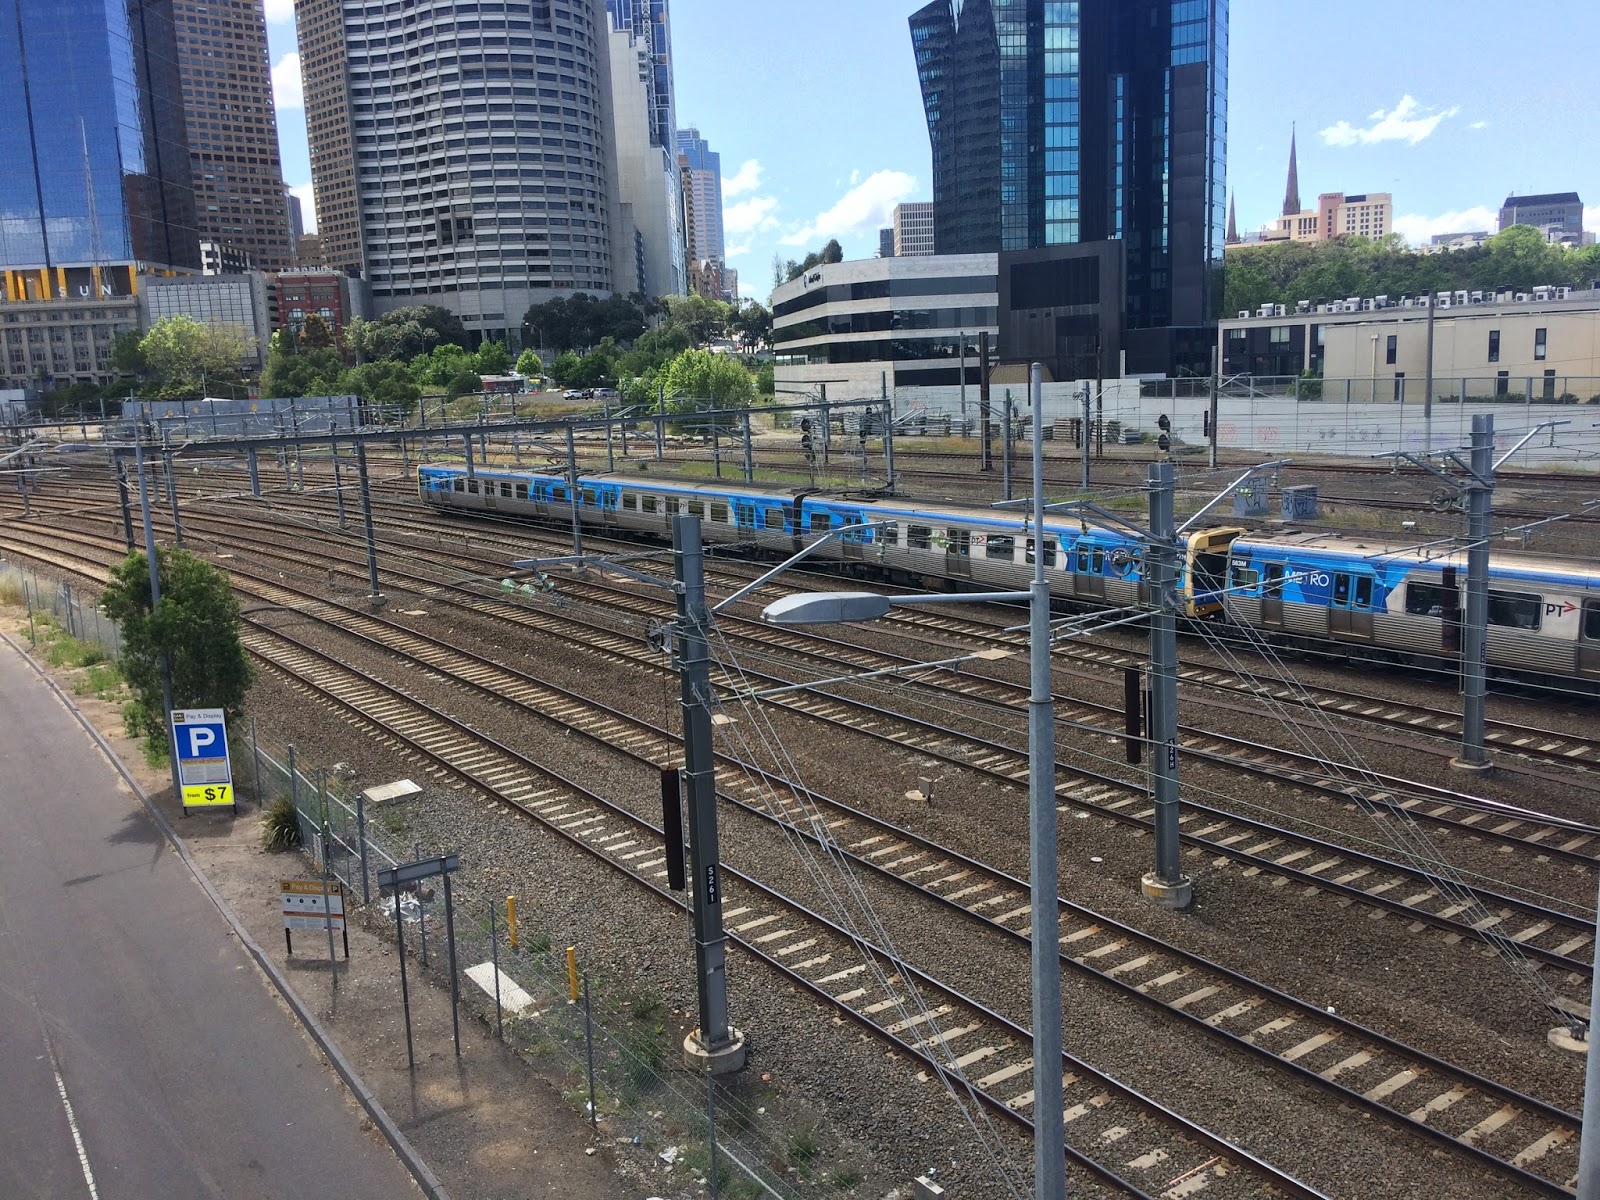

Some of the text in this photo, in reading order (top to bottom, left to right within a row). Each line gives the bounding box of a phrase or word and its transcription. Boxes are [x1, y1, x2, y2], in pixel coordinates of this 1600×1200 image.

[58, 284, 112, 298] SUN
[189, 727, 216, 757] P
[204, 786, 227, 802] $7
